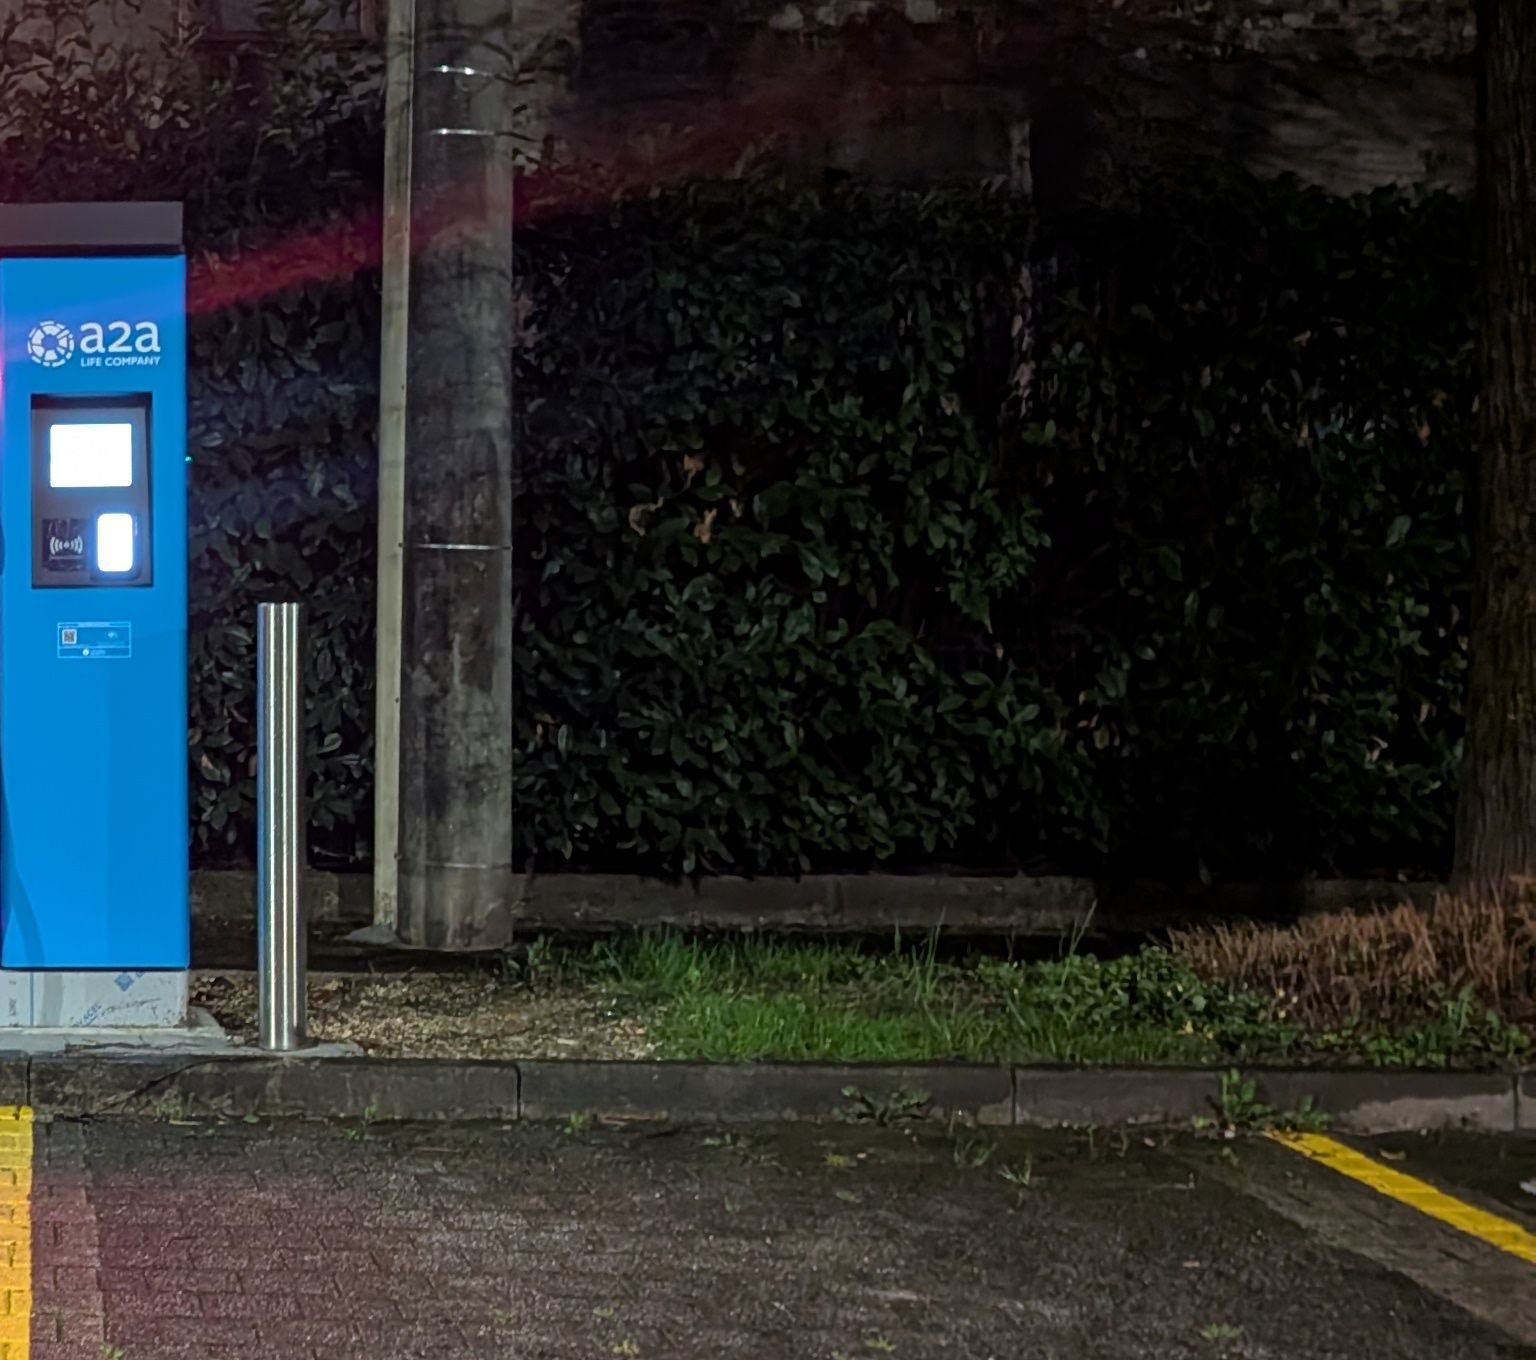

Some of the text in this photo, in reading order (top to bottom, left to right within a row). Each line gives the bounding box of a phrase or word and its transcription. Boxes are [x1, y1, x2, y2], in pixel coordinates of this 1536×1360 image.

[80, 321, 161, 353] a2a
[80, 356, 161, 367] LIFE COMPANY
